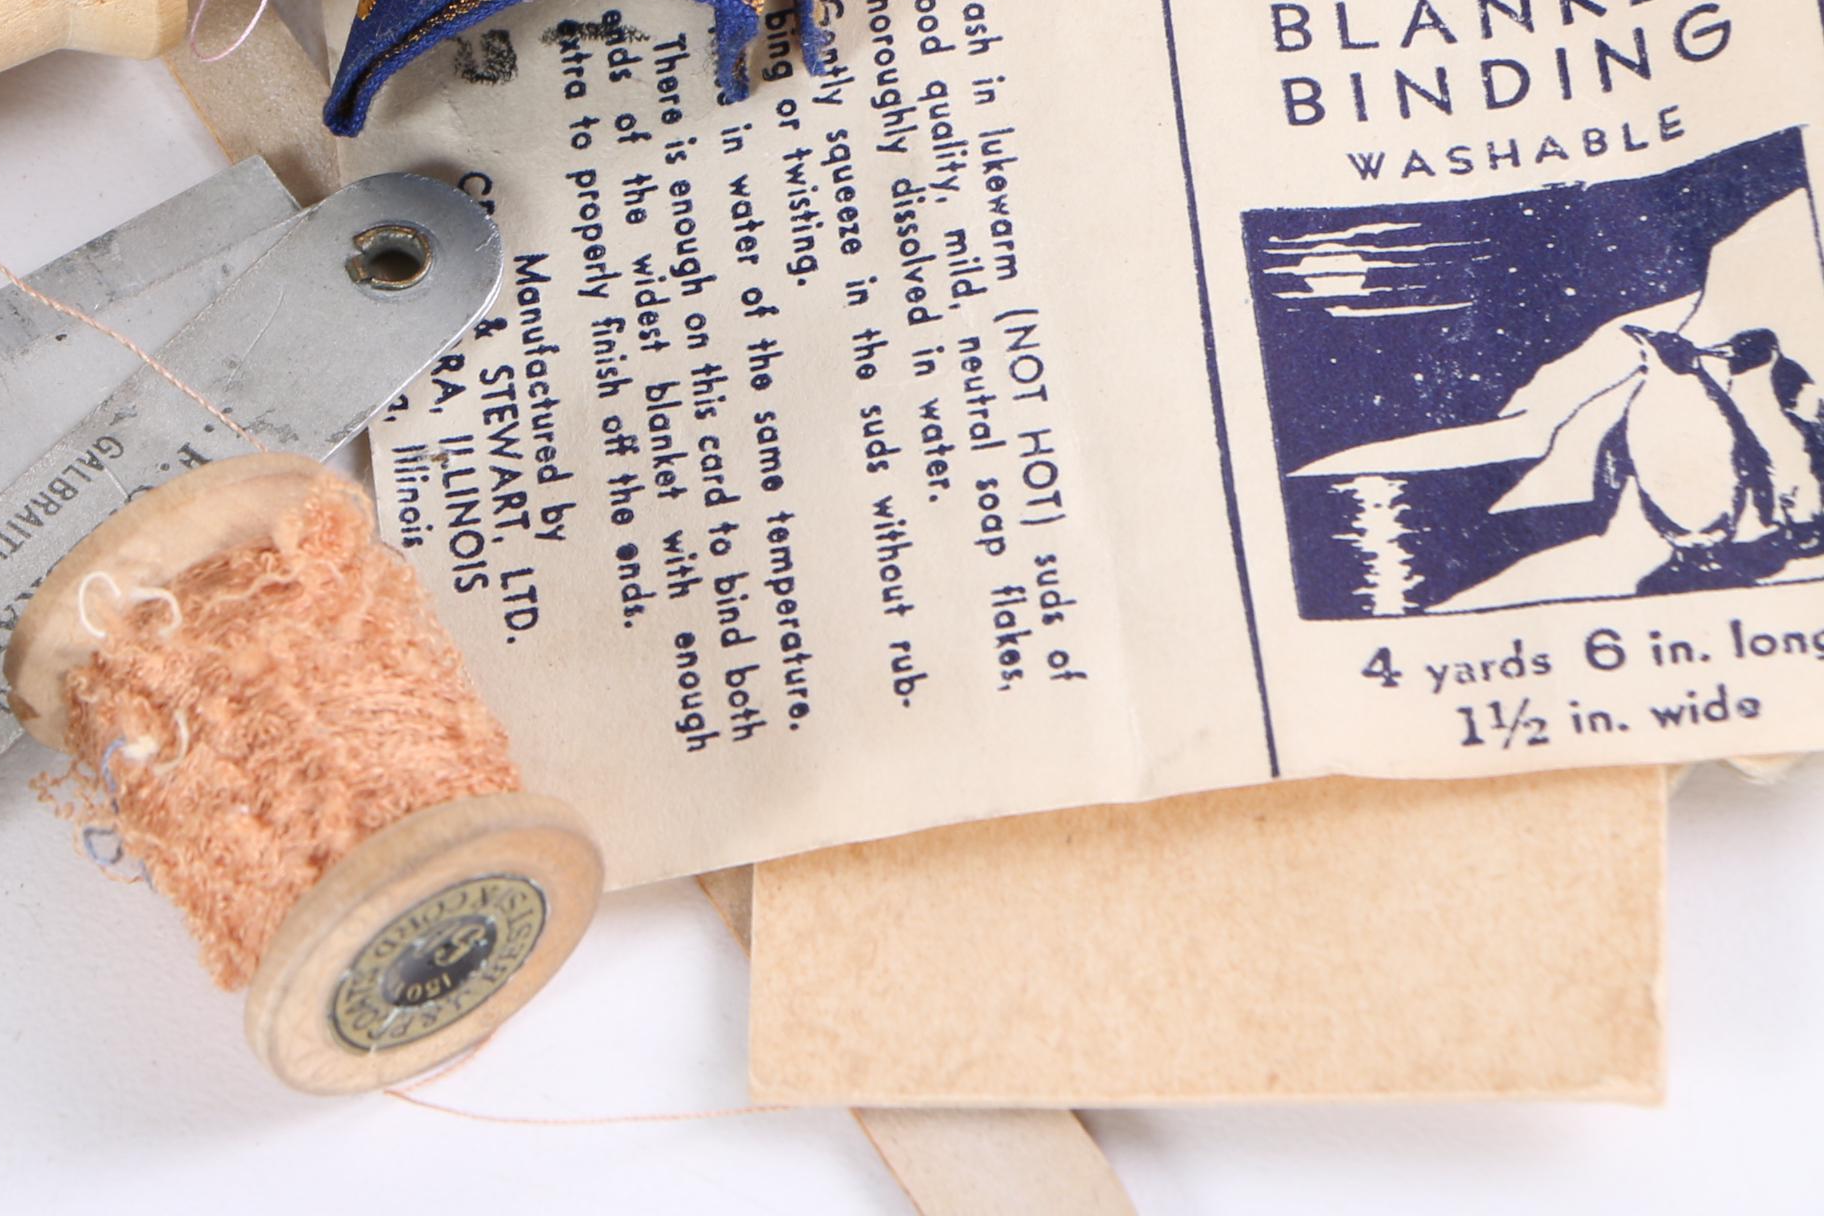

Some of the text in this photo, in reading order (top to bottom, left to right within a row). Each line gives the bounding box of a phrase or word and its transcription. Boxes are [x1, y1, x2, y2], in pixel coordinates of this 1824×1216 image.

[972, 74, 1007, 106] in
[1281, 2, 1732, 127] BINDING
[721, 122, 754, 155] in
[762, 9, 825, 286] bing or twisting.
[917, 79, 970, 204] quality,
[1347, 105, 1687, 182] WASHABLE
[728, 173, 766, 266] water
[820, 128, 864, 256] squeeze
[979, 126, 1019, 281] lukewarm
[845, 275, 879, 307] in
[890, 177, 945, 328] dissolved
[944, 227, 989, 311] mild,
[556, 18, 658, 629] extra to properly finish off the ends.
[741, 286, 781, 318] of
[513, 252, 578, 542] Manufactured by
[601, 8, 721, 754] ends of the widest blanket with enough
[653, 32, 768, 743] There is enough on this card to bind both
[746, 338, 785, 391] the
[852, 328, 889, 382] the
[910, 345, 946, 378] in
[957, 335, 1008, 452] neutral
[993, 309, 1050, 403] (NOT
[479, 364, 532, 544] STEWART,
[753, 410, 785, 492] same
[859, 403, 902, 474] suds
[918, 396, 956, 503] water.
[1018, 427, 1068, 526] HOT)
[392, 444, 435, 549] Illinois
[974, 477, 1008, 557] soap
[872, 495, 915, 617] without
[1033, 552, 1078, 626] suds
[500, 567, 540, 645] LTD.
[763, 510, 814, 733] temperature.
[990, 585, 1033, 693] flakes,
[1047, 649, 1088, 681] of
[1362, 646, 1403, 688] 4
[1425, 639, 1553, 694] yards
[1584, 628, 1627, 671] 6
[1648, 630, 1712, 666] in.
[1568, 700, 1630, 734] in.
[1650, 683, 1763, 730] wide
